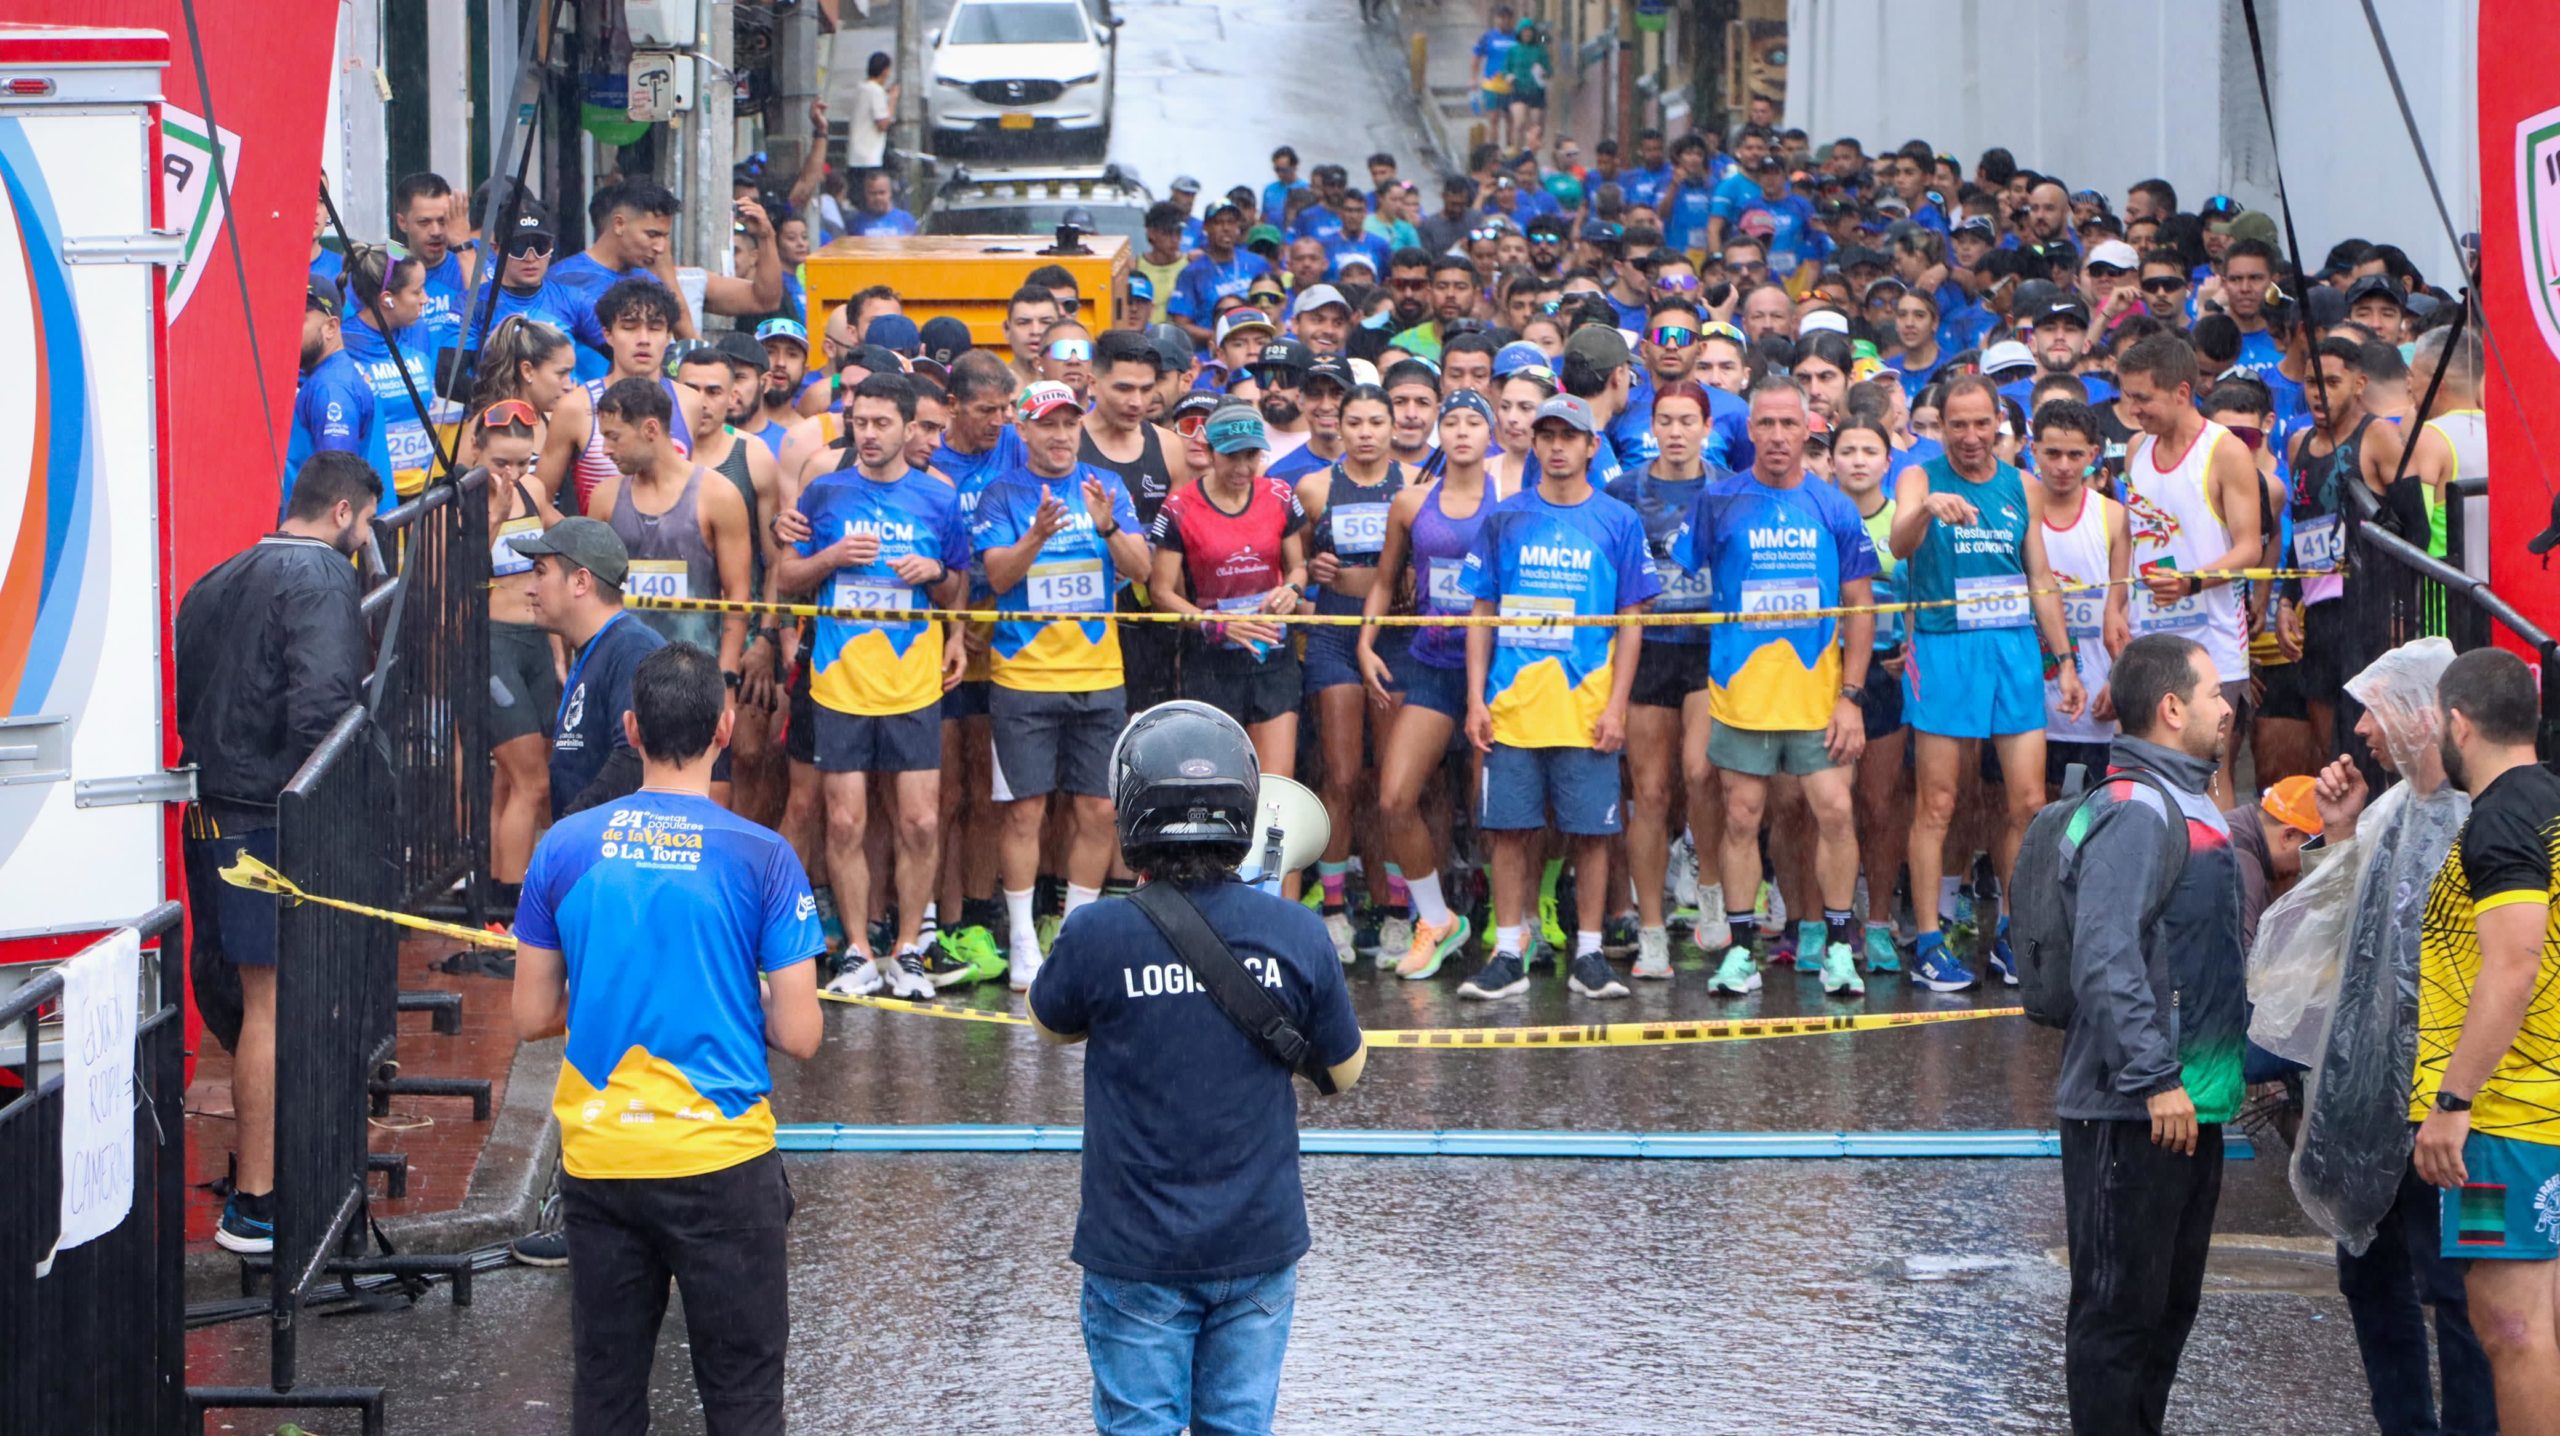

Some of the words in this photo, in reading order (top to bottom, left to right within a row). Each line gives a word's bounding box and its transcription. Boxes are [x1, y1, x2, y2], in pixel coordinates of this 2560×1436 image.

[520, 216, 539, 227] alo
[1266, 345, 1288, 355] FOX
[844, 519, 914, 541] MMCM
[1749, 528, 1817, 549] MMCM
[1954, 526, 2014, 542] Restaurante
[1519, 544, 1593, 570] MMCM
[1954, 542, 1972, 554] LAS
[627, 575, 676, 597] 140
[1039, 575, 1093, 599] 158
[1657, 572, 1707, 595] 248
[845, 590, 897, 609] 321
[1753, 593, 1808, 613] 408
[1661, 615, 1698, 625] PASE
[648, 820, 704, 831] populares
[602, 828, 623, 841] de
[627, 829, 644, 842] la
[643, 827, 703, 849] Vaca
[620, 843, 645, 860] La
[650, 845, 701, 863] Torre
[1123, 957, 1283, 998] LOGICA
